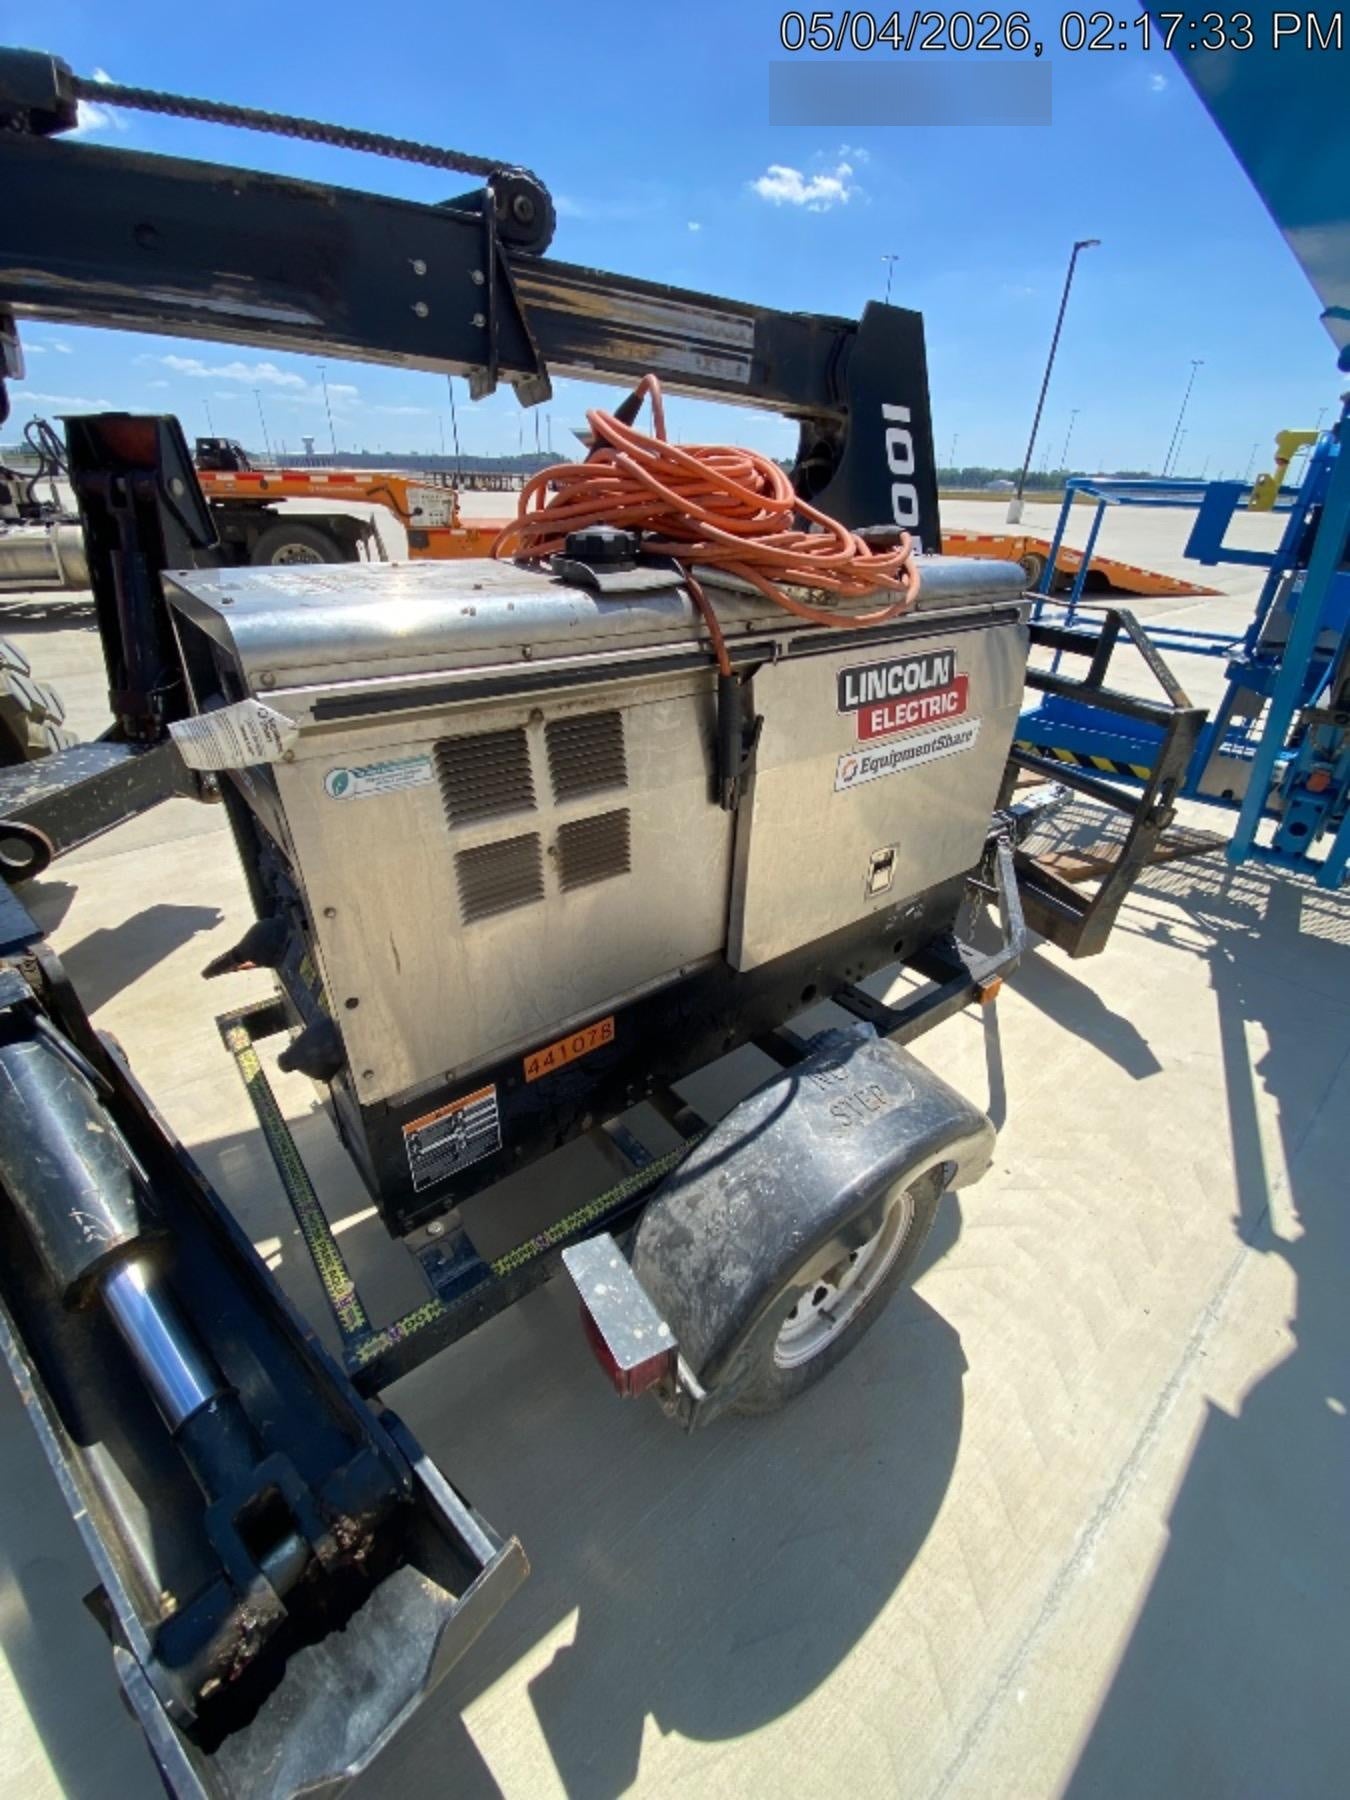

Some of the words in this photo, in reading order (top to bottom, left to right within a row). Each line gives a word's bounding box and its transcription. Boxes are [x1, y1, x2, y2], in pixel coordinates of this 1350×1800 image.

[844, 656, 950, 706] LINCOLN
[871, 691, 959, 733] ELECTRIC
[859, 729, 973, 775] EquipmentShare
[527, 1022, 613, 1076] 441078
